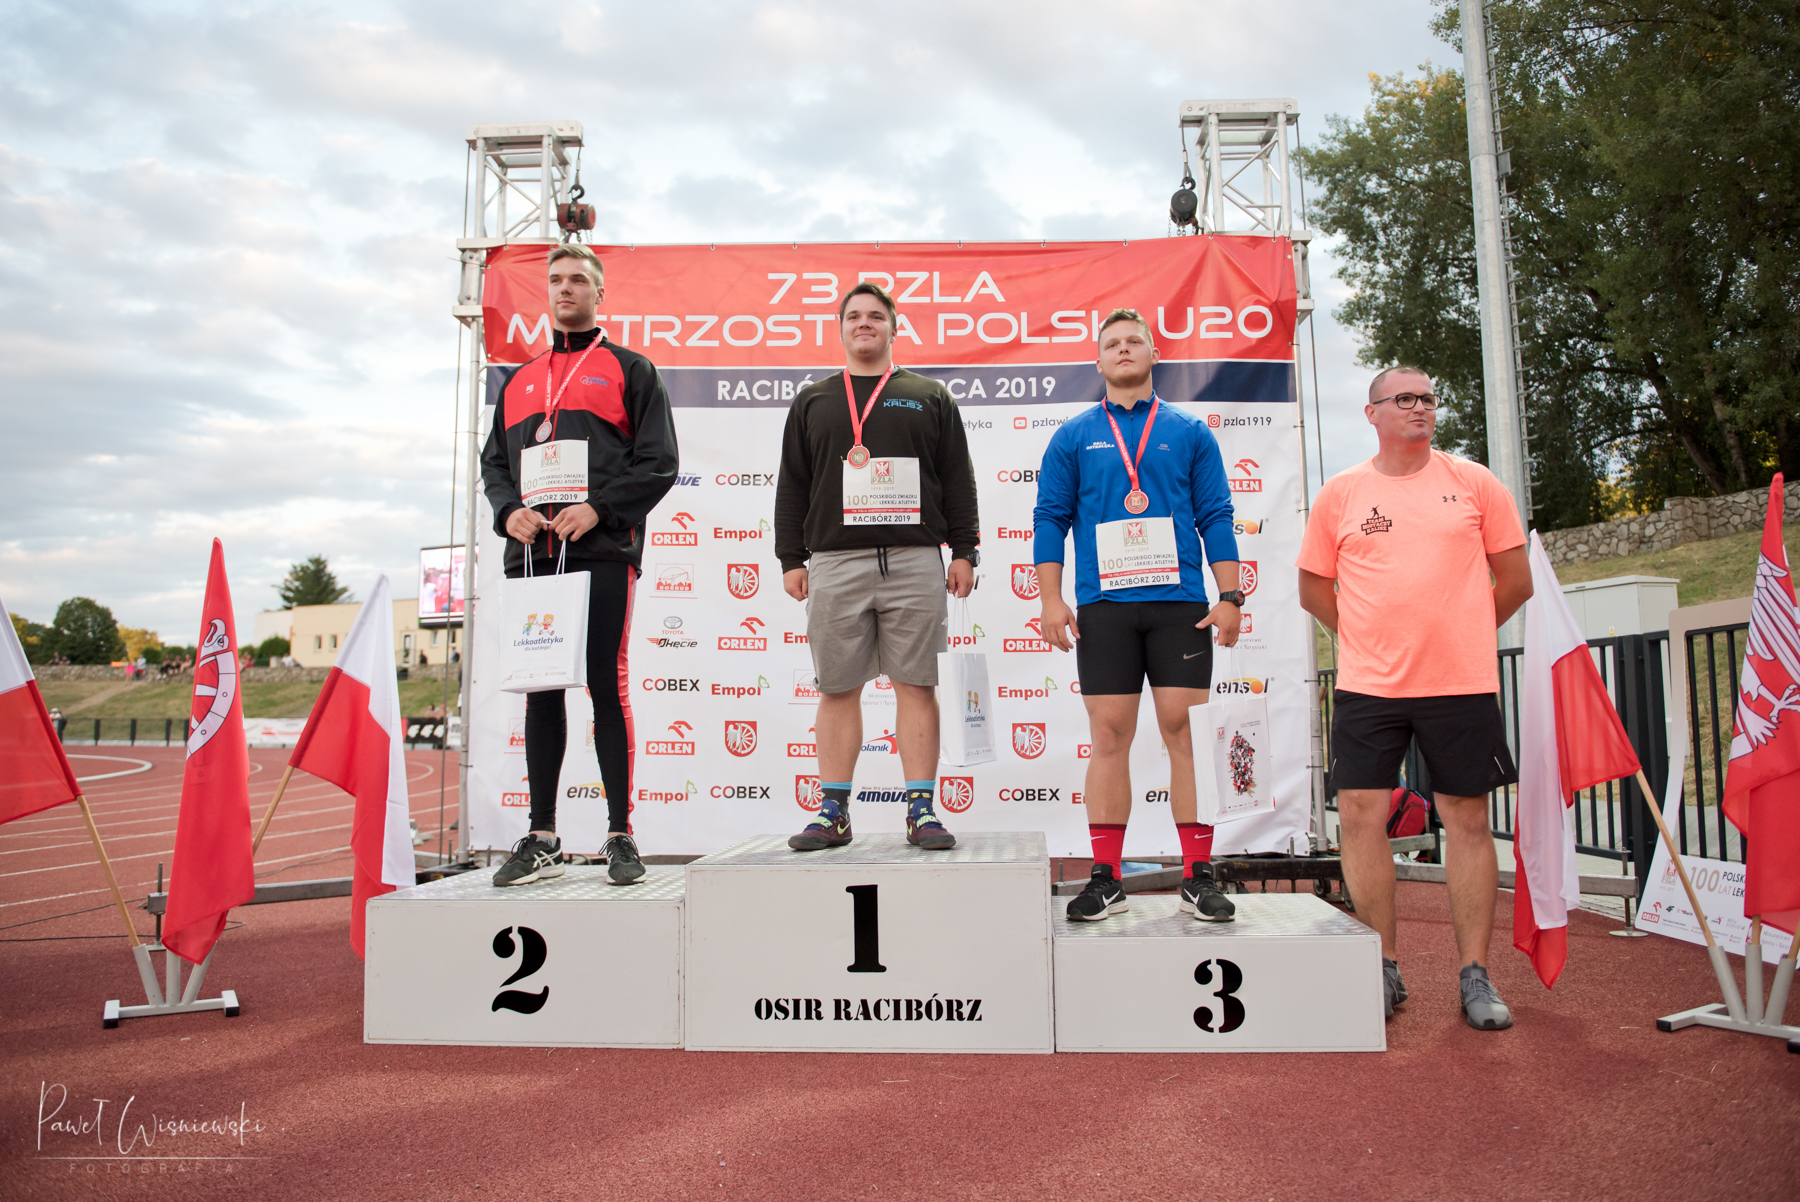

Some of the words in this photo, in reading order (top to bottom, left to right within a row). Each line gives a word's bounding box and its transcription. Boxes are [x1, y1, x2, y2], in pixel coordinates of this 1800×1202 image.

[767, 272, 839, 305] 73
[858, 270, 1006, 304] PZLA
[506, 313, 923, 348] MTRZOSTA
[938, 308, 1136, 344] POLSK
[1157, 304, 1274, 340] U20
[994, 376, 1057, 399] 2019
[883, 400, 924, 412] KALISZ
[1223, 416, 1273, 429] pzla1919
[522, 478, 539, 493] 100
[715, 474, 775, 487] COBEX
[872, 476, 893, 484] PZLA
[1229, 480, 1260, 491] RLEN
[527, 492, 559, 506] RACIBÓRZ
[560, 493, 578, 501] 2019
[846, 494, 868, 506] 100
[852, 513, 893, 523] RACIBÓRZ
[894, 515, 911, 523] 2019
[653, 534, 695, 545] ORLEN
[713, 527, 763, 542] Empol
[997, 527, 1035, 542] Emp
[1124, 537, 1147, 546] PZLA
[1101, 558, 1123, 571] 100
[1109, 575, 1150, 588] RACIBÓRZ
[1151, 575, 1170, 583] 2019
[513, 636, 564, 647] Lekkoatletyka
[720, 638, 764, 650] ORLEN
[1005, 640, 1050, 651] ORLEN
[642, 678, 701, 692] COBEX
[711, 683, 761, 699] Empol
[1216, 678, 1269, 695] ensol
[997, 686, 1049, 701] Empol
[648, 742, 692, 754] ORLEN
[789, 744, 816, 756] ORL
[860, 743, 889, 752] olanik
[638, 789, 689, 804] Empol
[710, 785, 771, 800] COBEX
[998, 788, 1060, 802] COBEX
[503, 794, 530, 805] ORL
[1689, 866, 1720, 893] 100
[1722, 871, 1746, 884] POLSK
[1718, 885, 1733, 895] LAT
[1642, 913, 1659, 923] ORLEN
[846, 884, 887, 974] 1
[491, 925, 550, 1015] 2
[1193, 958, 1246, 1034] 3
[754, 997, 824, 1022] OSIR
[833, 992, 983, 1022] RACIBÓRZ
